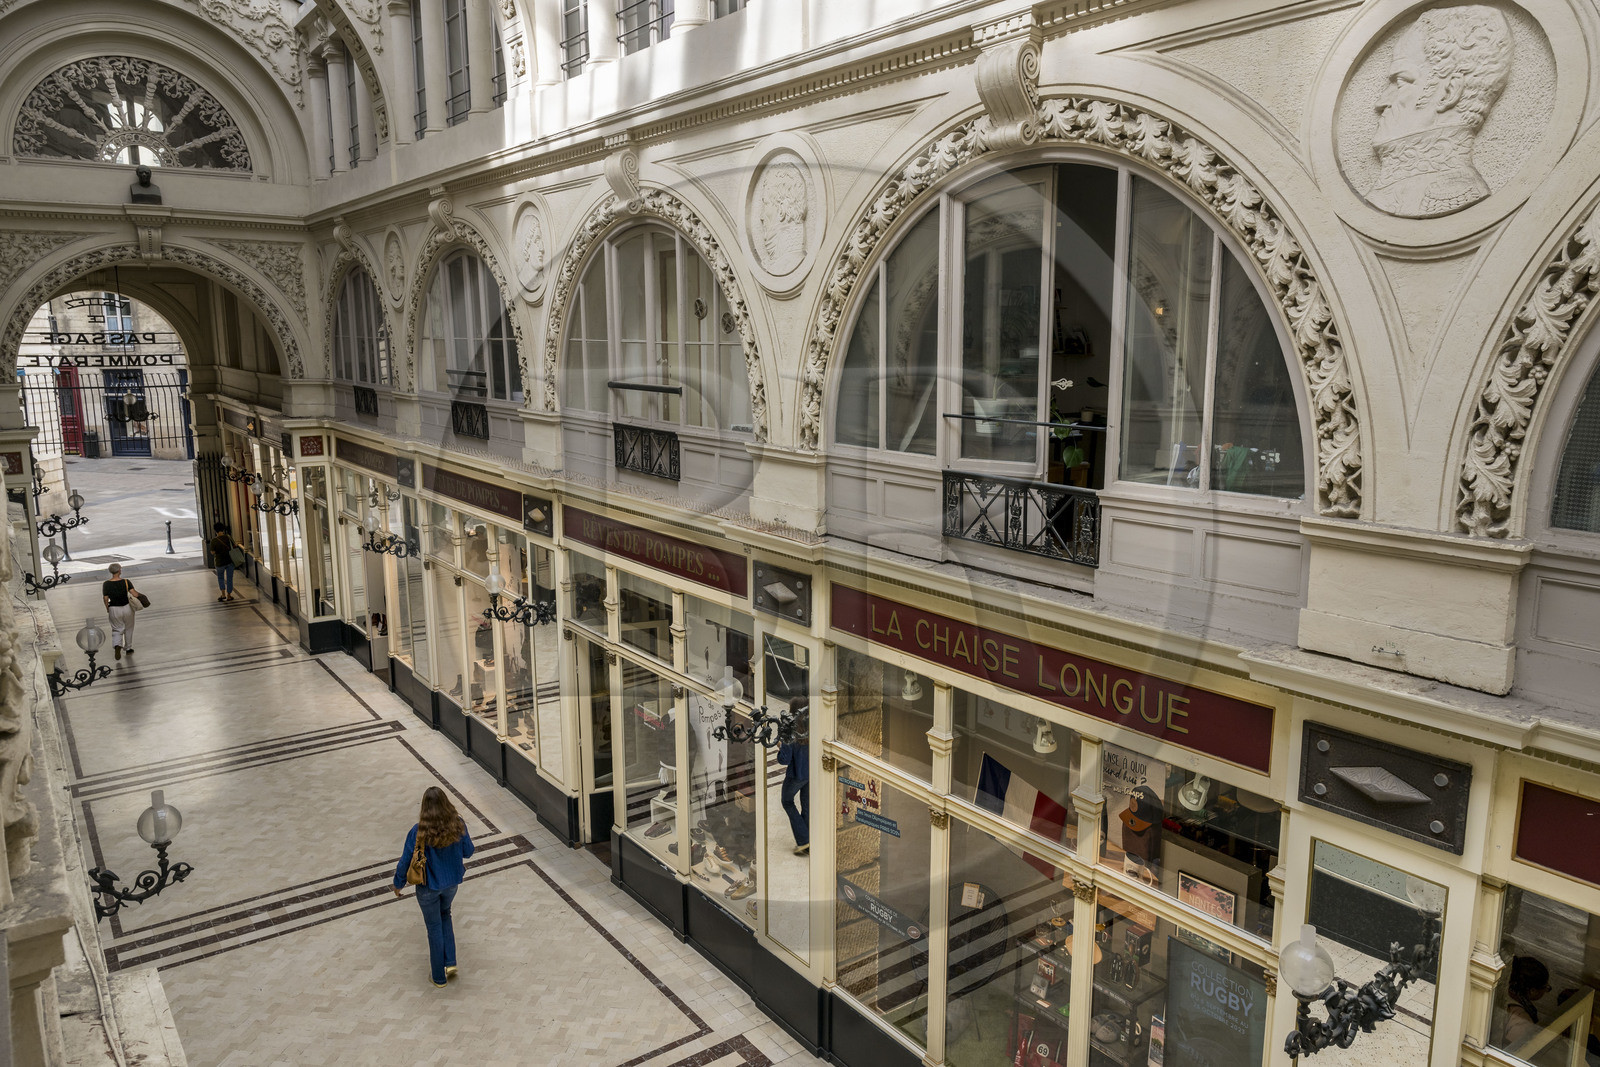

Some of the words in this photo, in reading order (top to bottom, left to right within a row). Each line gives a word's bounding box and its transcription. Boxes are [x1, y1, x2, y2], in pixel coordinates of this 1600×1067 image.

[467, 484, 500, 508] POMPES
[582, 515, 620, 549] RÊVES
[623, 530, 641, 555] DE
[645, 538, 704, 576] POMPES
[871, 604, 903, 641] LA
[915, 618, 1020, 680] CHAISE
[1037, 654, 1191, 734] LONGUE
[1130, 760, 1147, 776] QUOI
[870, 902, 893, 923] RUGBY
[1188, 894, 1223, 918] NANTES
[1191, 961, 1254, 1000] COLLECTION
[1191, 972, 1254, 1017] RUGBY
[1037, 1046, 1048, 1056] 69
